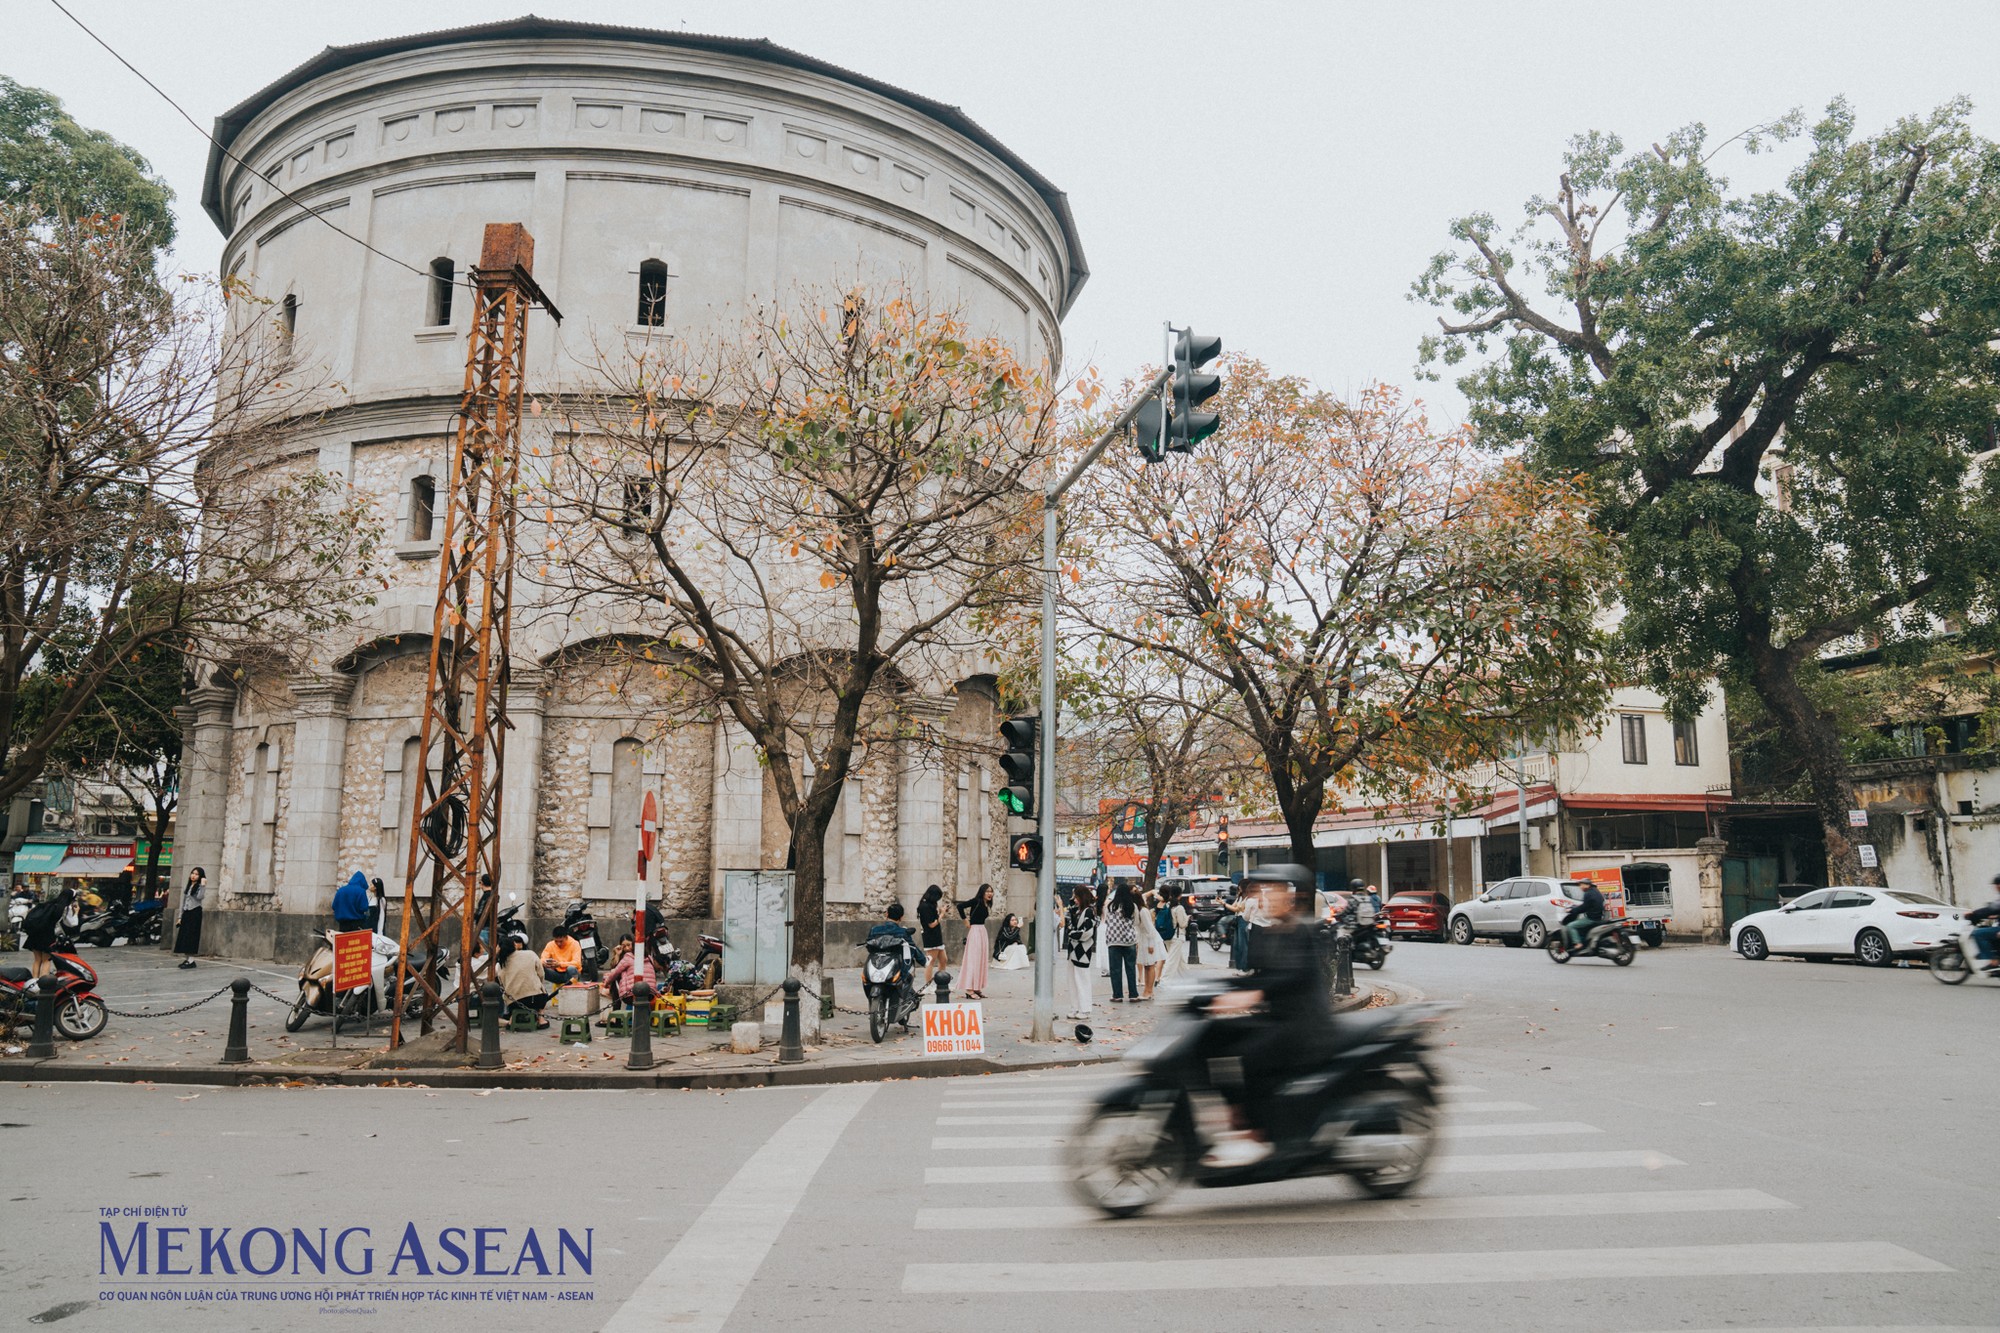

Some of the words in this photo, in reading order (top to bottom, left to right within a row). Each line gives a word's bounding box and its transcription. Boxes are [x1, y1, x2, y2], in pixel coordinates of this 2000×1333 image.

[111, 847, 131, 856] NINH
[925, 1004, 981, 1037] KHÓA
[927, 1040, 953, 1053] 09666
[955, 1039, 981, 1052] 11044
